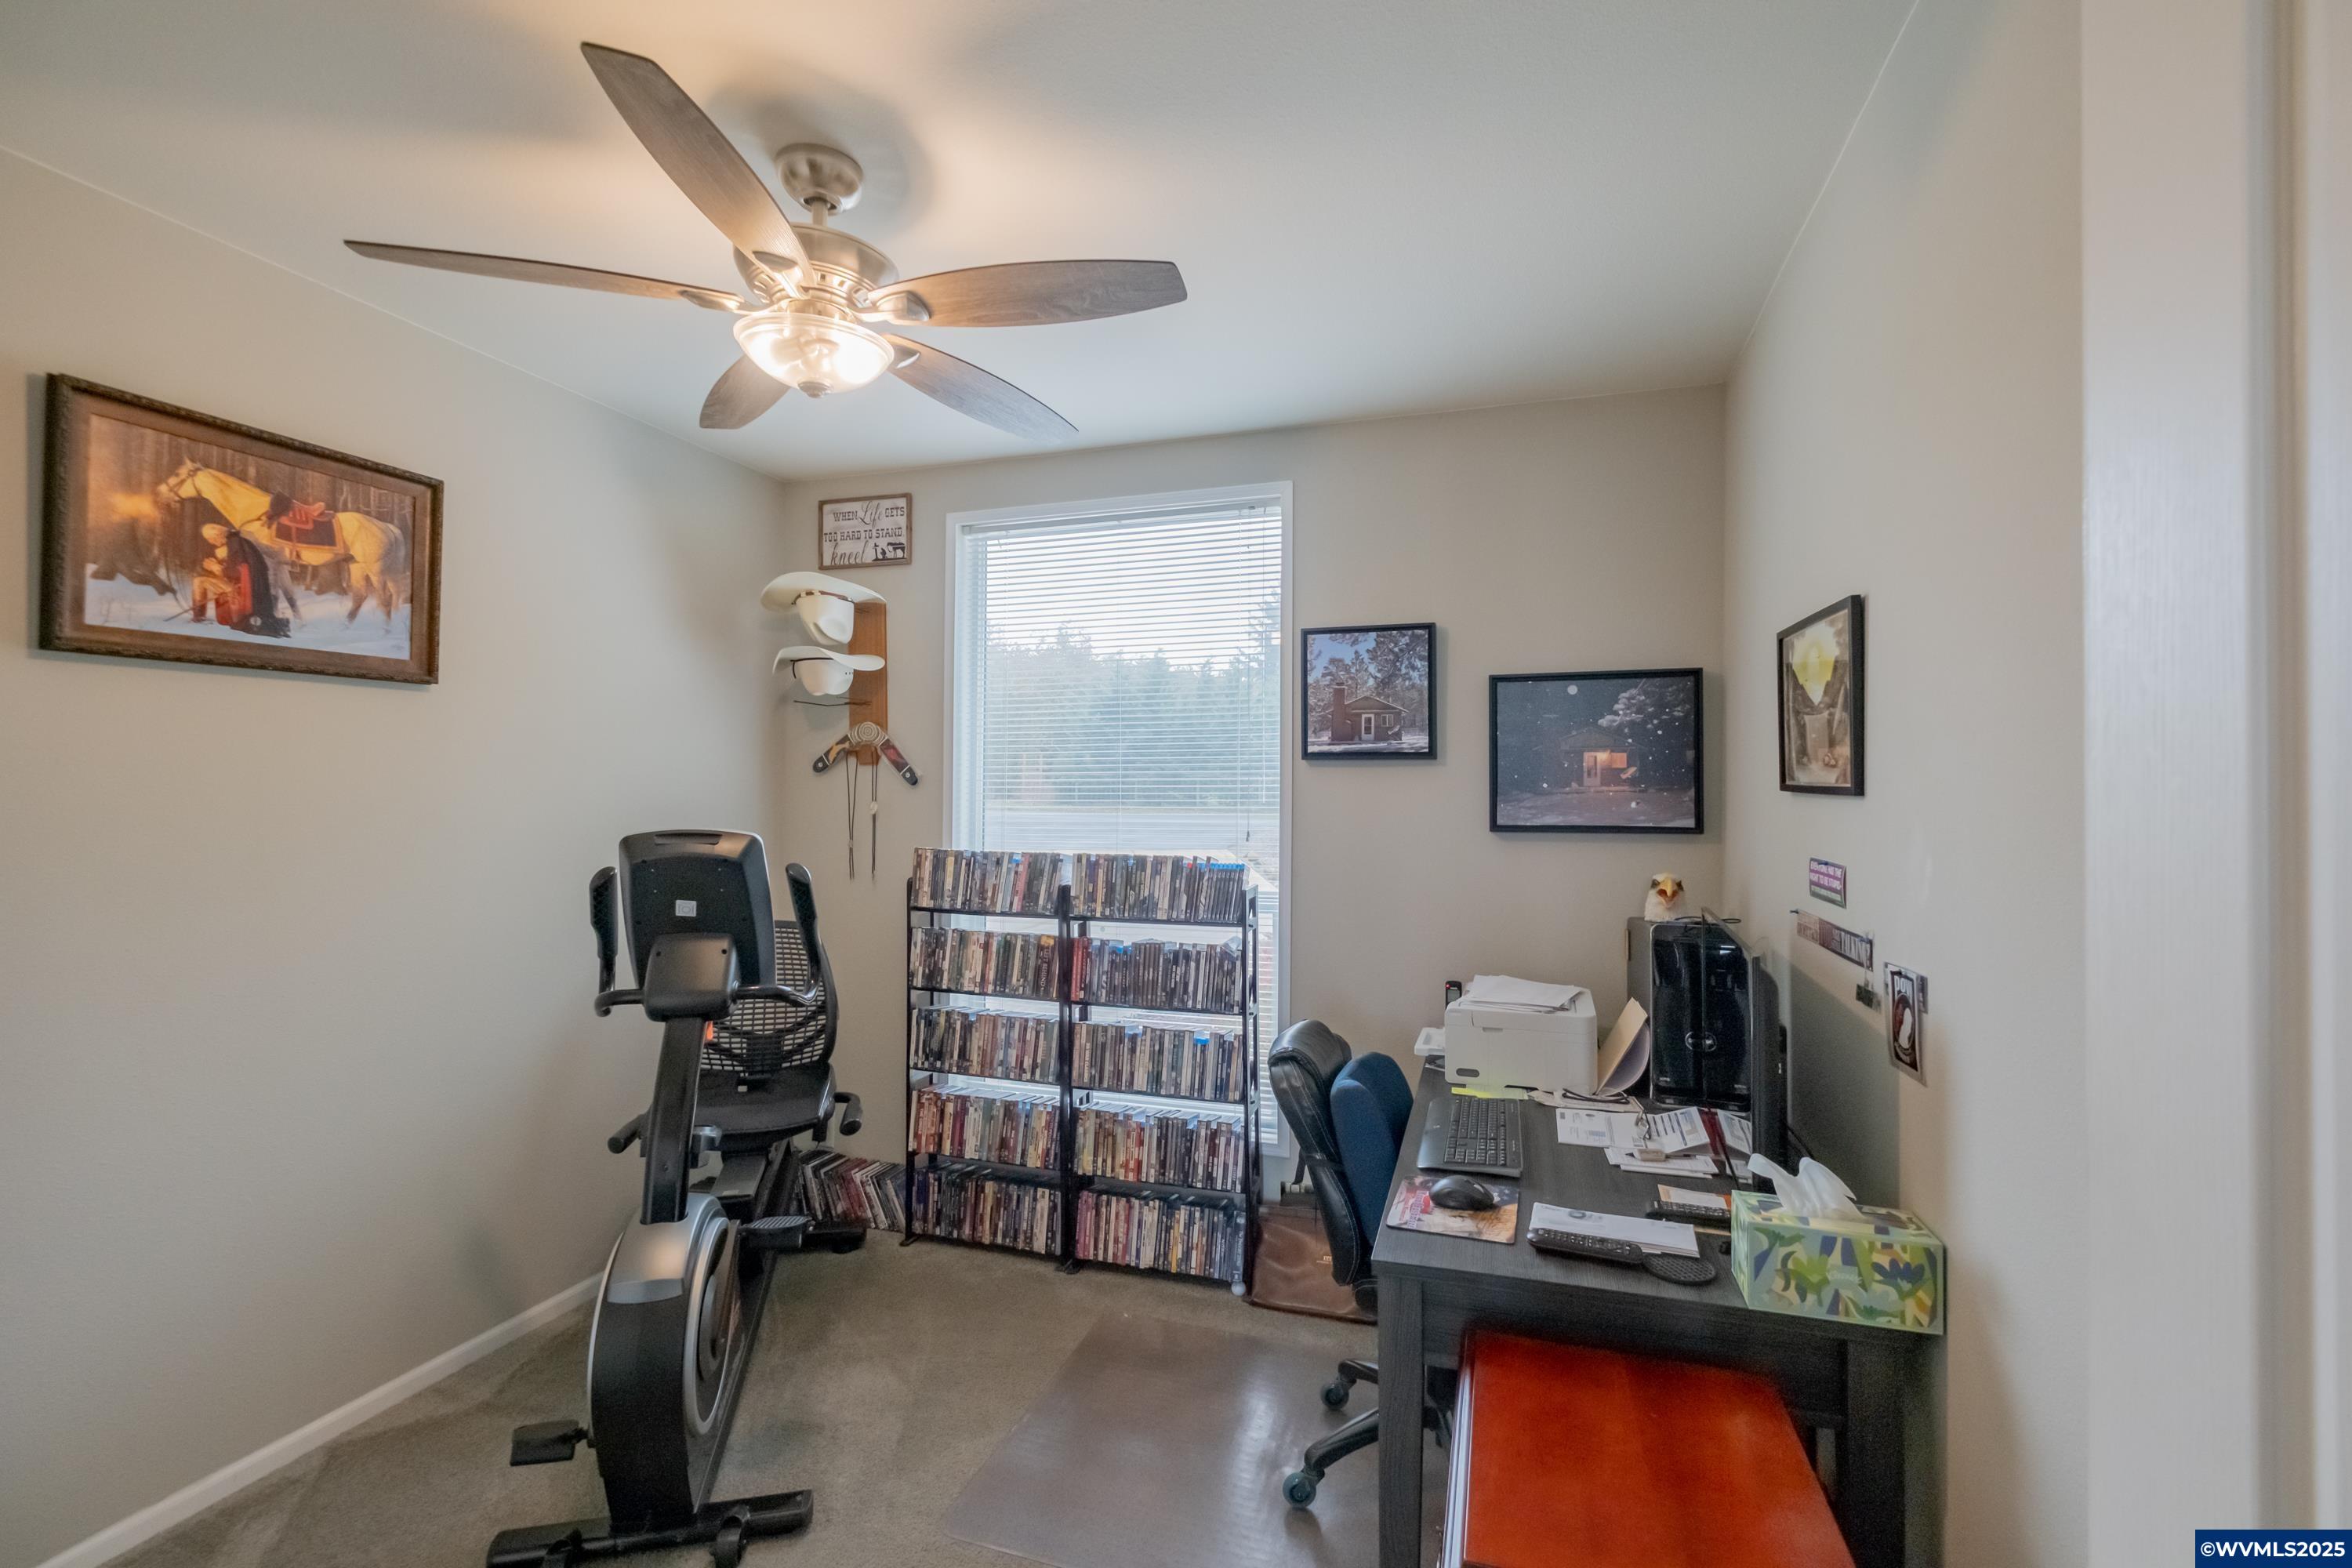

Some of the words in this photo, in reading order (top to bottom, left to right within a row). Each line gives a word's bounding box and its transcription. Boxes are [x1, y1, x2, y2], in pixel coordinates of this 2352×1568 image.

[833, 510, 858, 522] WHEN
[858, 500, 882, 528] Life
[884, 506, 905, 517] GETS
[824, 532, 838, 543] TOO
[840, 530, 862, 541] HARD
[863, 529, 873, 539] TO
[875, 527, 902, 539] STAND
[830, 539, 869, 564] kneel
[1894, 975, 1914, 1001] POW
